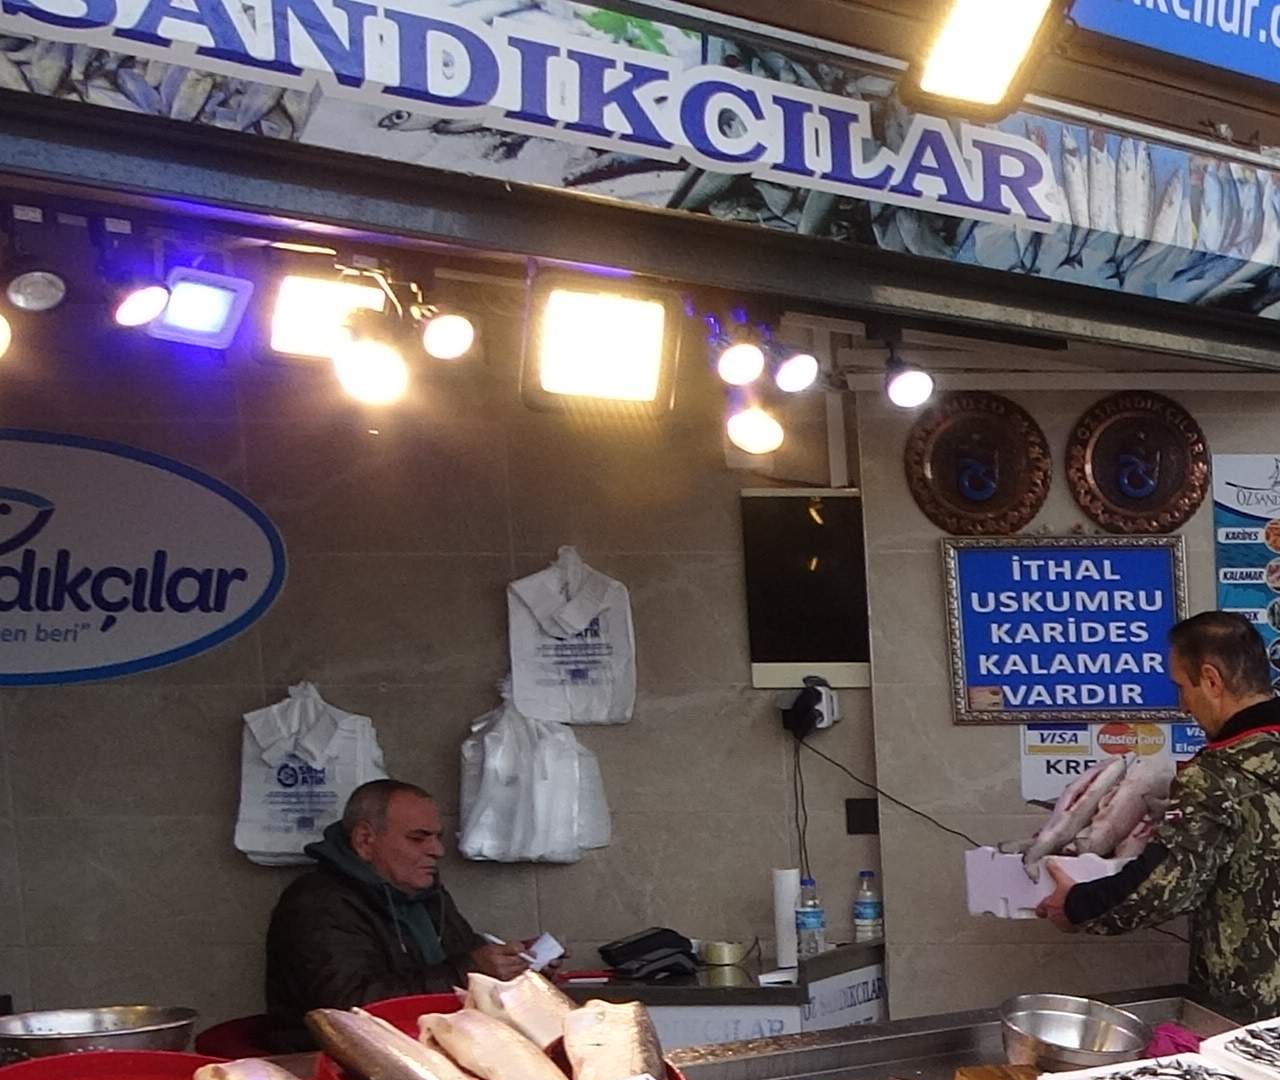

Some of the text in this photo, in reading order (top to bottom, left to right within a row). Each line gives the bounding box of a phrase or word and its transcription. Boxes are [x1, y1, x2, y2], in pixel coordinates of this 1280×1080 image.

[1012, 555, 1121, 581] İTHAL
[971, 590, 1163, 613] USKUMRU
[990, 618, 1149, 643] KARİDES
[979, 653, 1165, 675] KALAMAR
[1002, 683, 1144, 706] VARDIR
[1039, 732, 1079, 744] VISA
[1186, 727, 1206, 737] VIS
[1046, 759, 1097, 775] KRE
